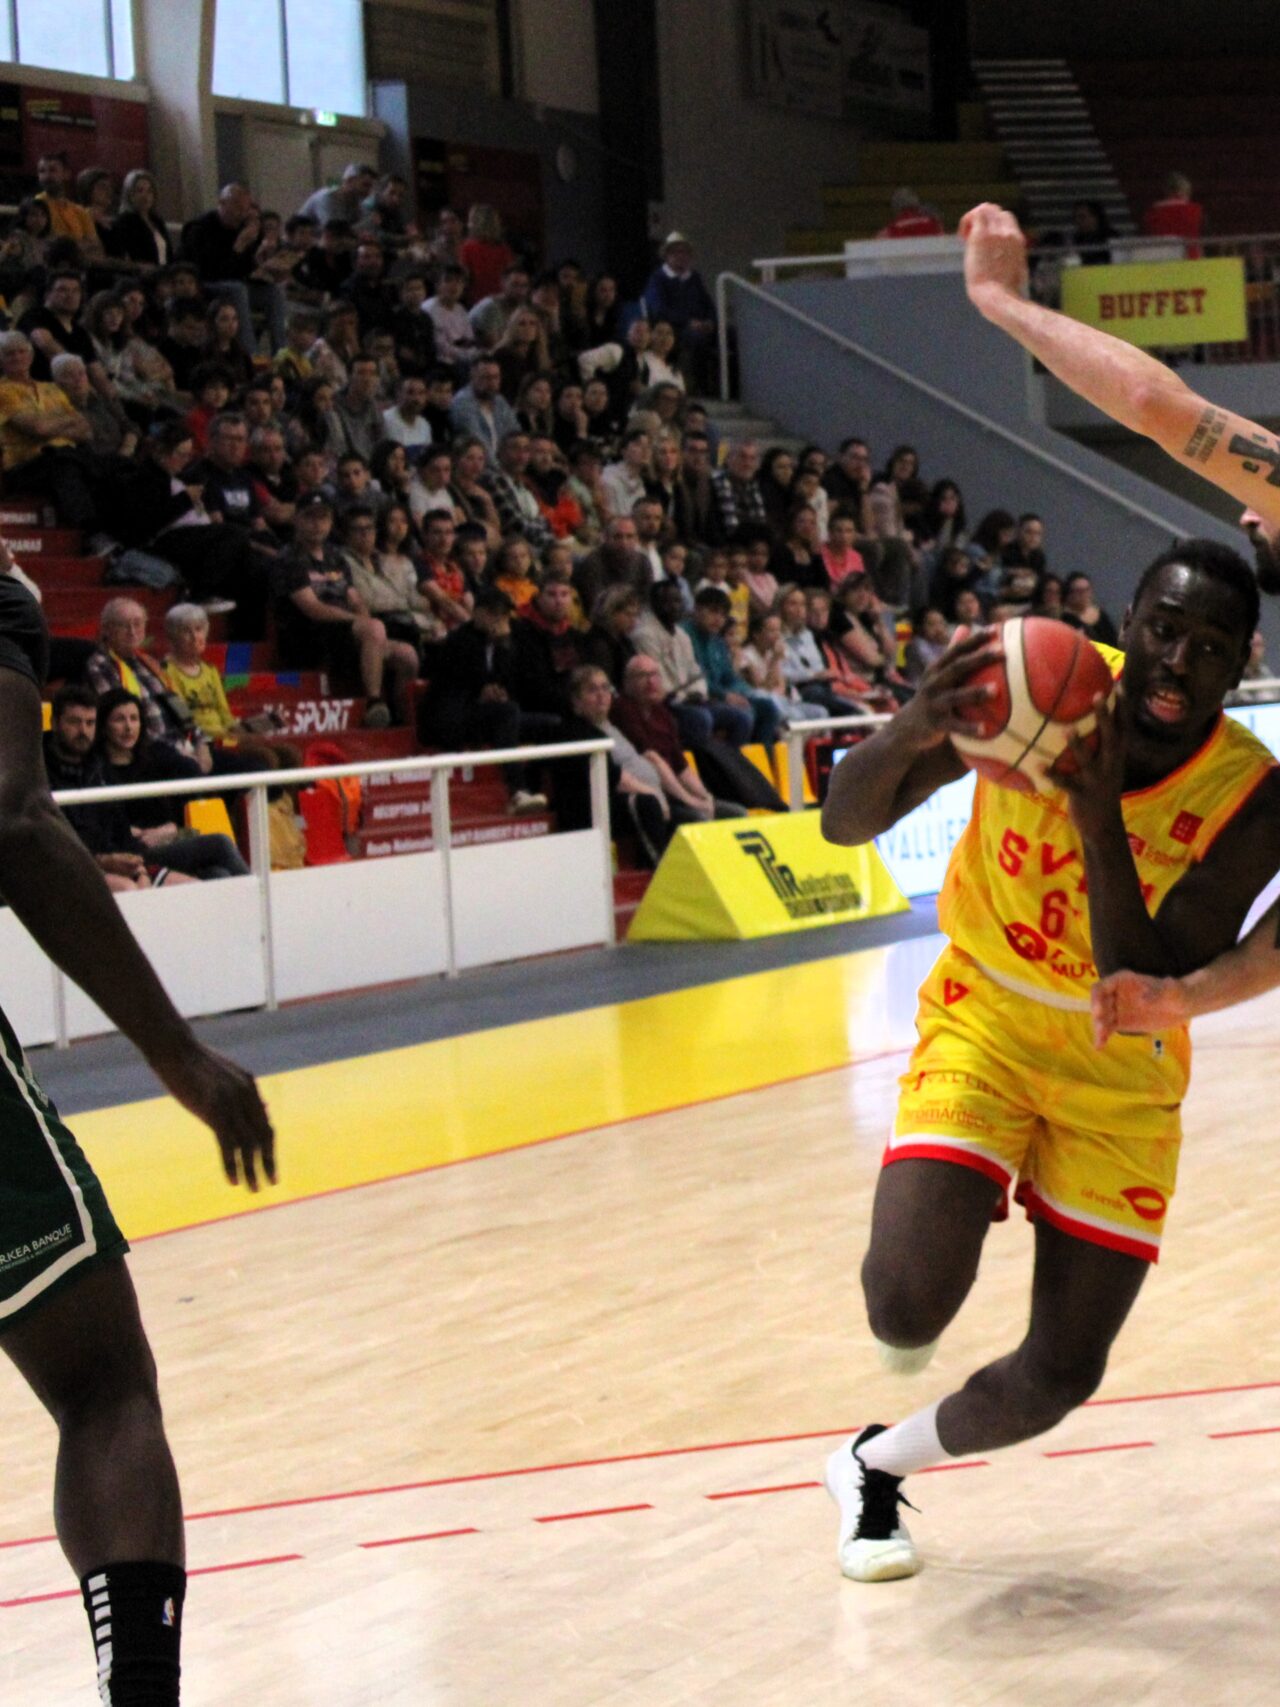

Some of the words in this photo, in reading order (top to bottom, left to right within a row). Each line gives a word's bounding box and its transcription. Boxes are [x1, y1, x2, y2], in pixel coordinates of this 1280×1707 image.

[1098, 288, 1207, 320] BUFFET
[293, 698, 354, 734] SPORT
[32, 1224, 72, 1249] BANQUE
